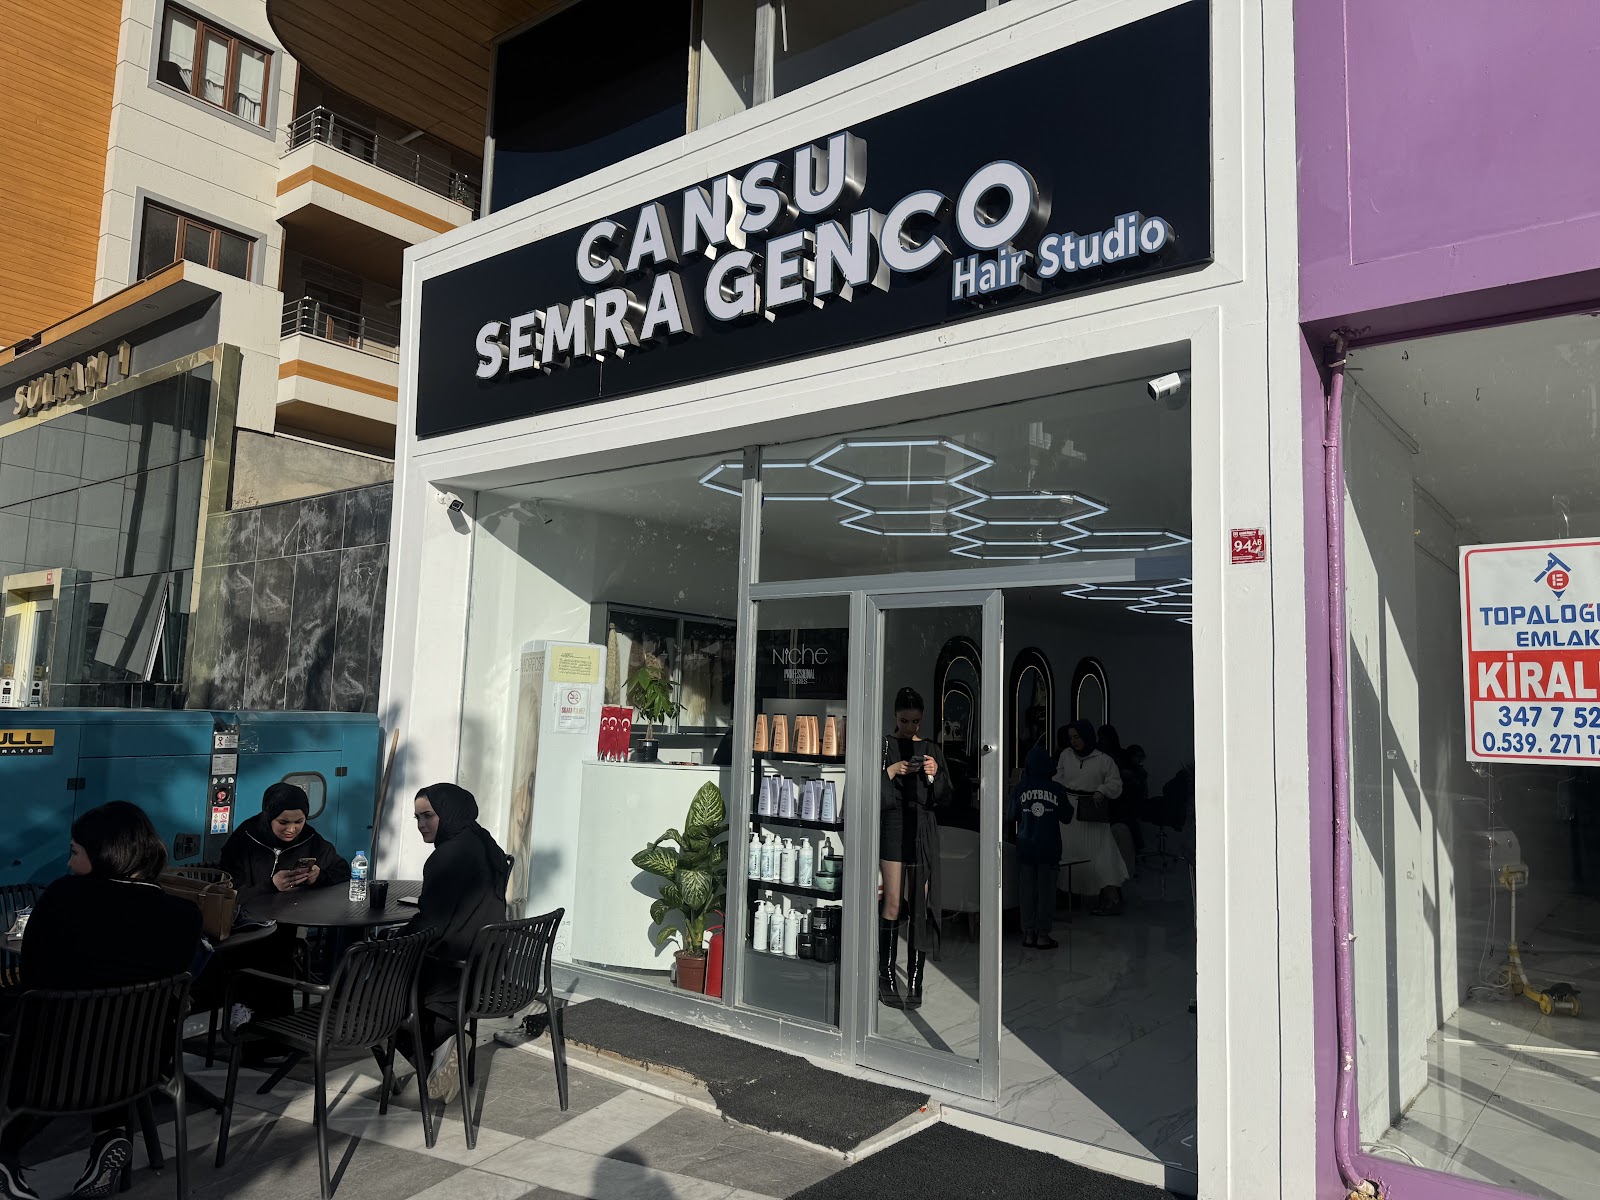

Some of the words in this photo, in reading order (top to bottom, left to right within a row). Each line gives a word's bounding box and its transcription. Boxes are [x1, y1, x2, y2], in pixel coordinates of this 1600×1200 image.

[576, 131, 852, 285] CANSU
[952, 246, 1026, 300] Hair
[1037, 211, 1168, 278] Studio
[475, 271, 687, 379] SEMRA
[704, 160, 1038, 321] GENCO
[1480, 603, 1600, 625] TOPALOĞ
[1516, 629, 1600, 647] EMLAK
[772, 643, 829, 665] Niche
[1477, 653, 1600, 699] KİRAL
[1498, 705, 1542, 728] 347
[1550, 706, 1564, 728] 7
[1573, 706, 1600, 728] 52
[1482, 732, 1542, 753] 0.539.
[1549, 733, 1581, 754] 271
